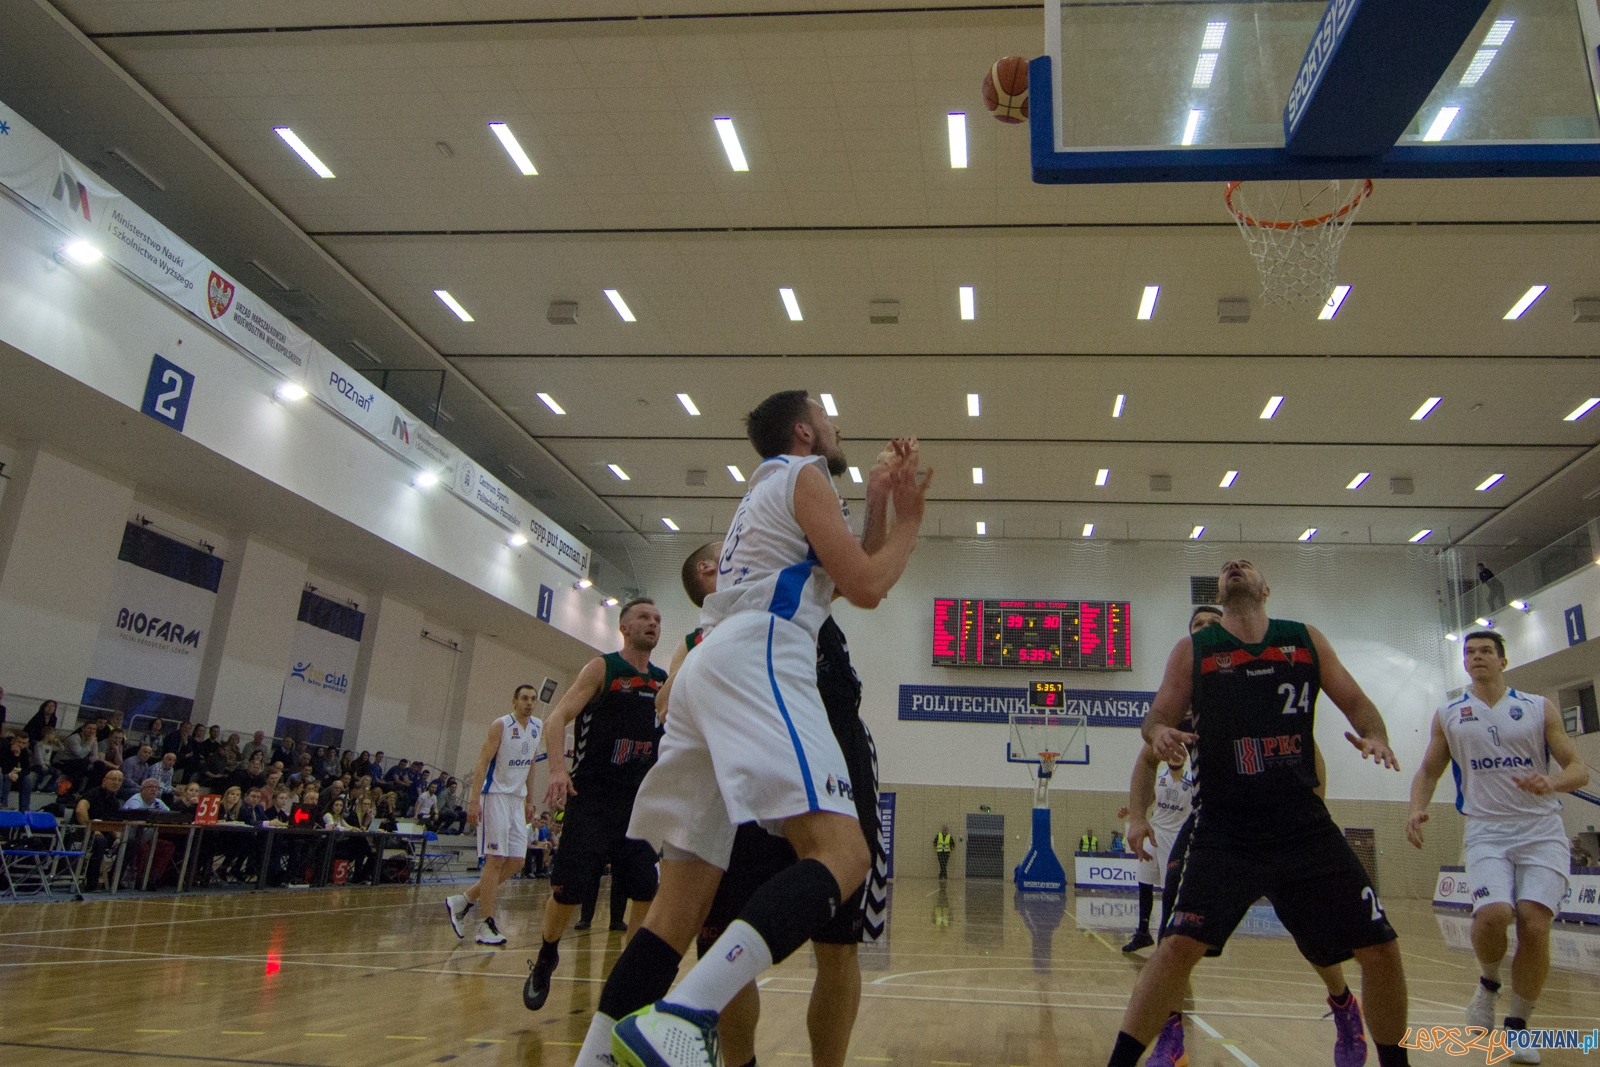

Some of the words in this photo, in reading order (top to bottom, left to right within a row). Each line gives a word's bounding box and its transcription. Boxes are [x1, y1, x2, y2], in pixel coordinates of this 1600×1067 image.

[112, 210, 161, 252] Ministerstwo
[162, 246, 185, 268] Nauki
[113, 226, 158, 265] Szkolnictwa
[159, 259, 194, 290] Wyższego
[154, 369, 183, 421] 2
[530, 519, 589, 571] cspp.put.poznan.pl
[541, 591, 549, 618] 1
[116, 607, 200, 648] BIOFARM
[1007, 615, 1023, 628] 39
[1043, 615, 1060, 629] 30
[1569, 611, 1580, 641] 1
[1246, 666, 1275, 677] hummel
[1046, 692, 1056, 706] 2
[1046, 696, 1151, 717] ZNAŃSKA
[1277, 681, 1310, 715] 24
[1261, 734, 1302, 757] PEC
[1487, 725, 1501, 747] 1
[1470, 756, 1534, 770] BIOFARM
[335, 862, 348, 879] 5
